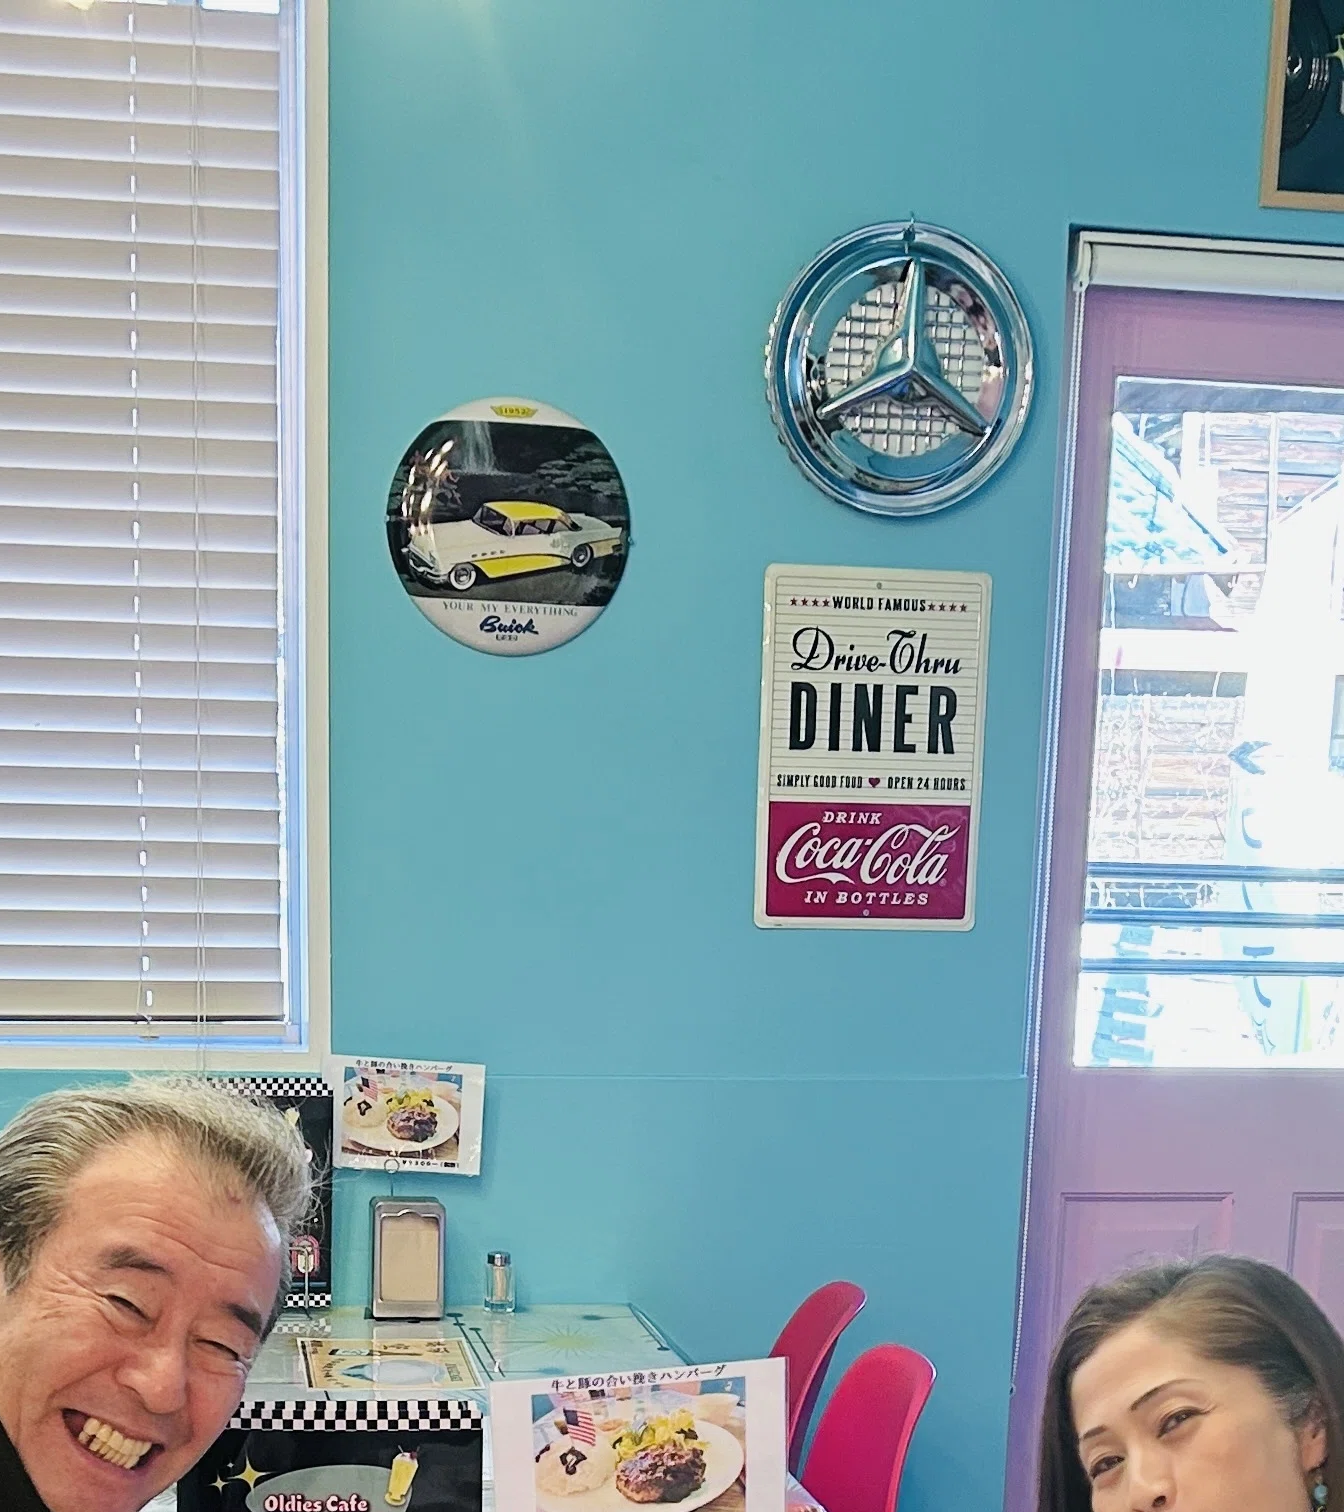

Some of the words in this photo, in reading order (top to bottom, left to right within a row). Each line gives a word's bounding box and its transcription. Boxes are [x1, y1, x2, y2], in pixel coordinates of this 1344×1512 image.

[442, 600, 474, 611] YOUR
[481, 602, 498, 613] MY
[504, 603, 578, 617] EVERYTHING
[832, 596, 874, 611] WORLD
[878, 598, 926, 612] FAMOUS
[479, 615, 539, 635] Buick
[790, 625, 962, 675] Drive-Thru
[788, 681, 958, 755] DINER
[777, 773, 811, 788] SIMPLY
[813, 775, 837, 789] GOOD
[840, 775, 863, 789] FOOD
[887, 776, 914, 790] OPEN
[917, 777, 929, 790] 24
[933, 777, 966, 791] HOURS
[821, 810, 883, 825] DRINK
[775, 822, 962, 885] Coca-Cola
[804, 890, 828, 905] IN
[836, 891, 929, 906] BOTTLES
[326, 1493, 370, 1512] Cafe
